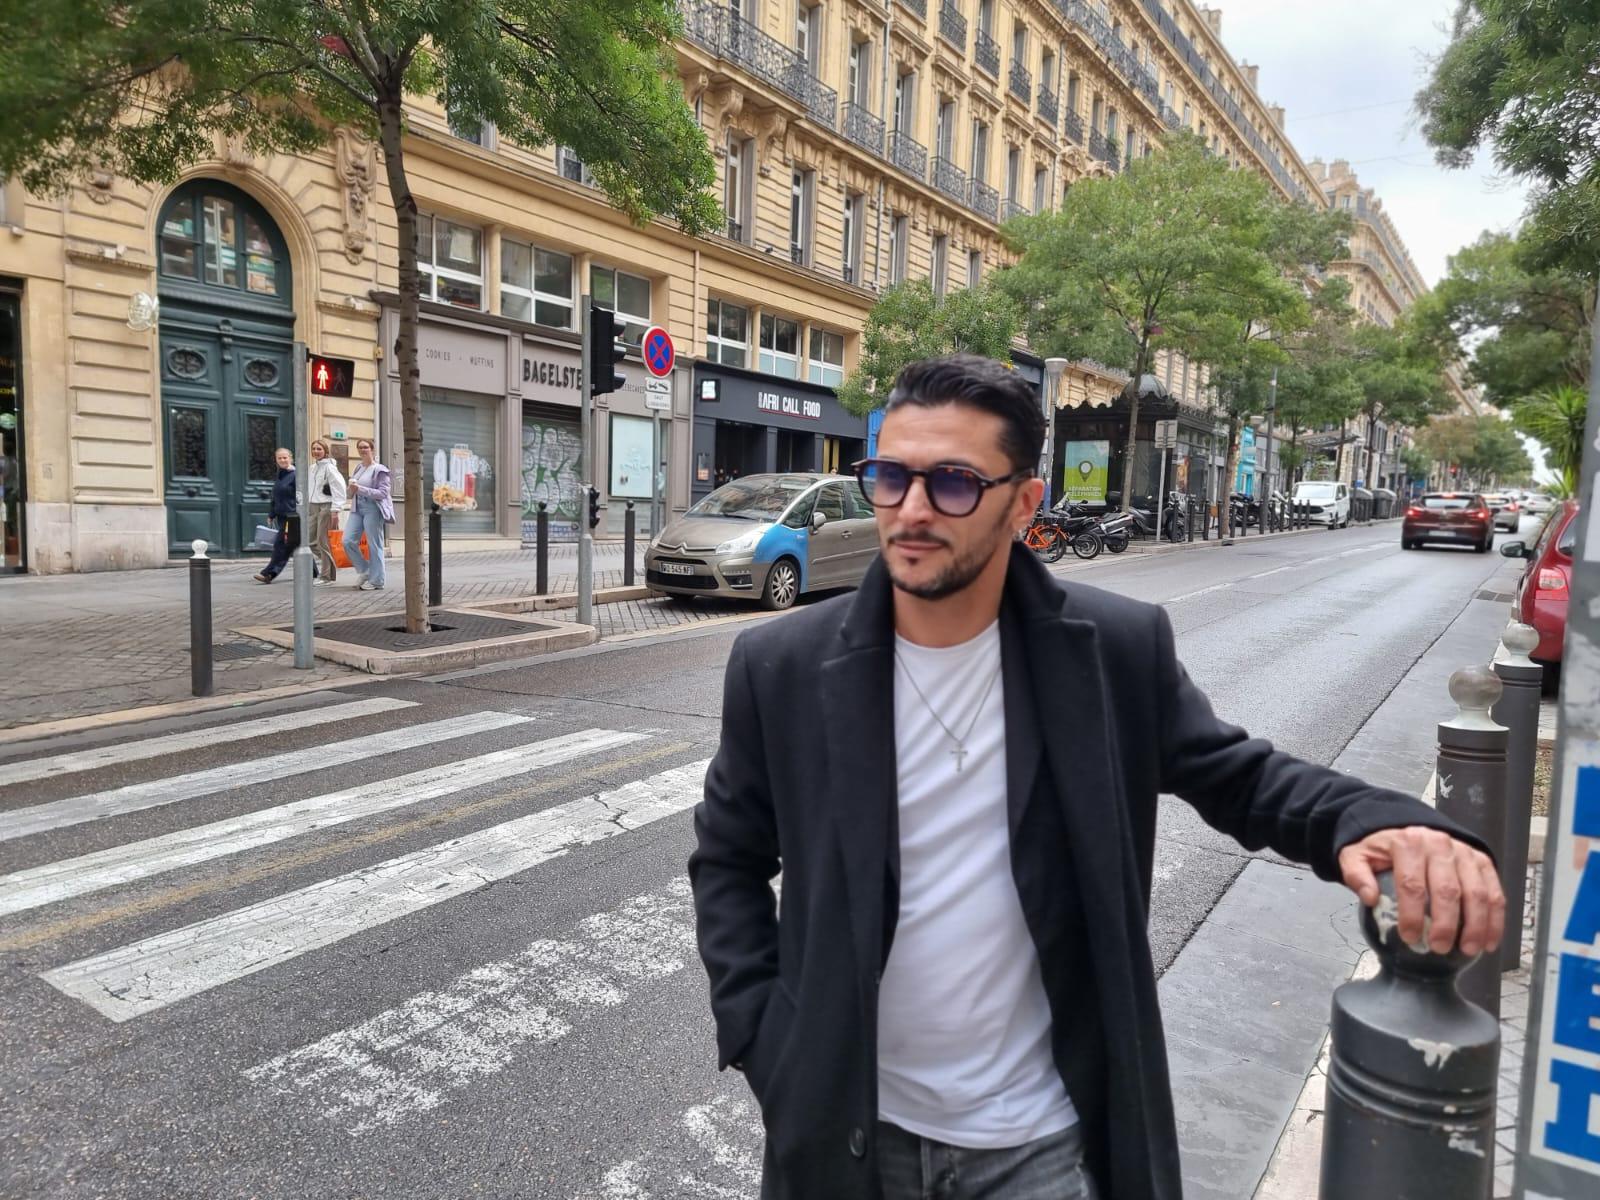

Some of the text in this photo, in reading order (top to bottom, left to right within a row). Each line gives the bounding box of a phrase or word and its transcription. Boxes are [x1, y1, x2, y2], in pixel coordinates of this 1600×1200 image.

[523, 358, 582, 390] BAGELSTE
[782, 396, 800, 415] CALL
[803, 400, 821, 418] FOOD
